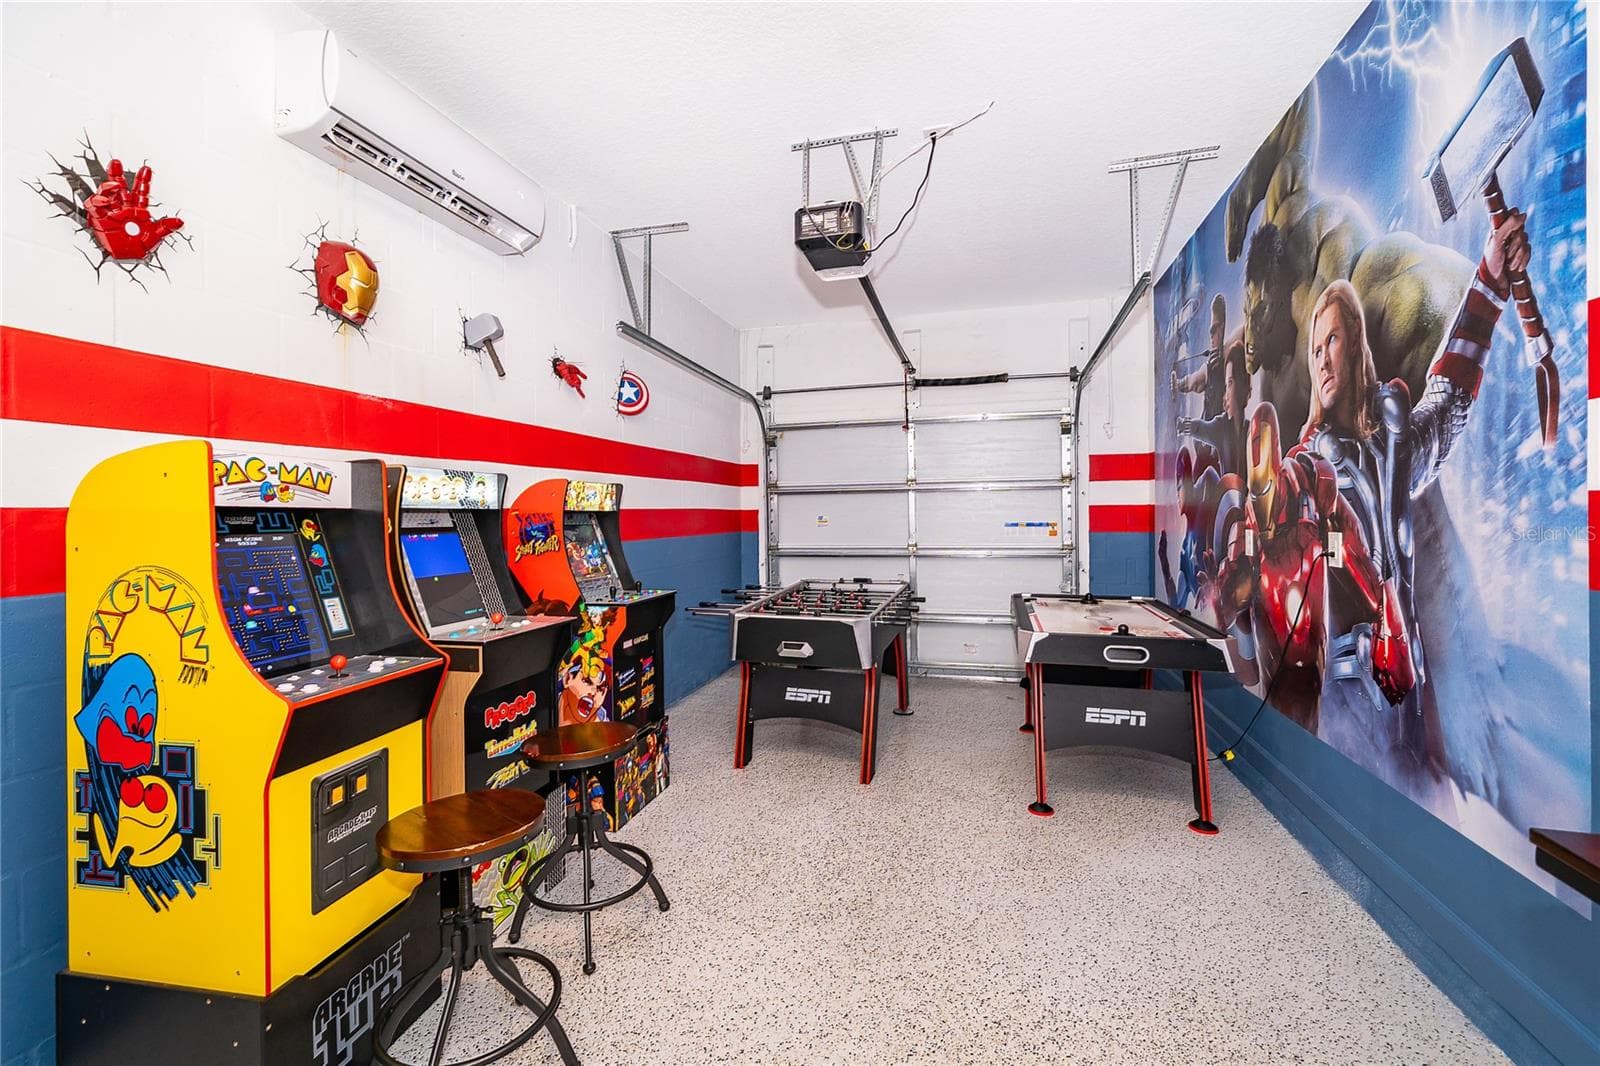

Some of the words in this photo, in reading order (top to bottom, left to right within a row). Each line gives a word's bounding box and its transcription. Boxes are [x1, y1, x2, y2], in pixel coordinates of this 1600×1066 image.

[213, 457, 334, 495] PAC-MAN
[87, 574, 210, 665] PAC-MAN
[484, 690, 537, 730] FROGGER
[784, 686, 832, 704] ESPN
[1085, 706, 1147, 727] ESPN
[312, 939, 403, 1038] ARCADE
